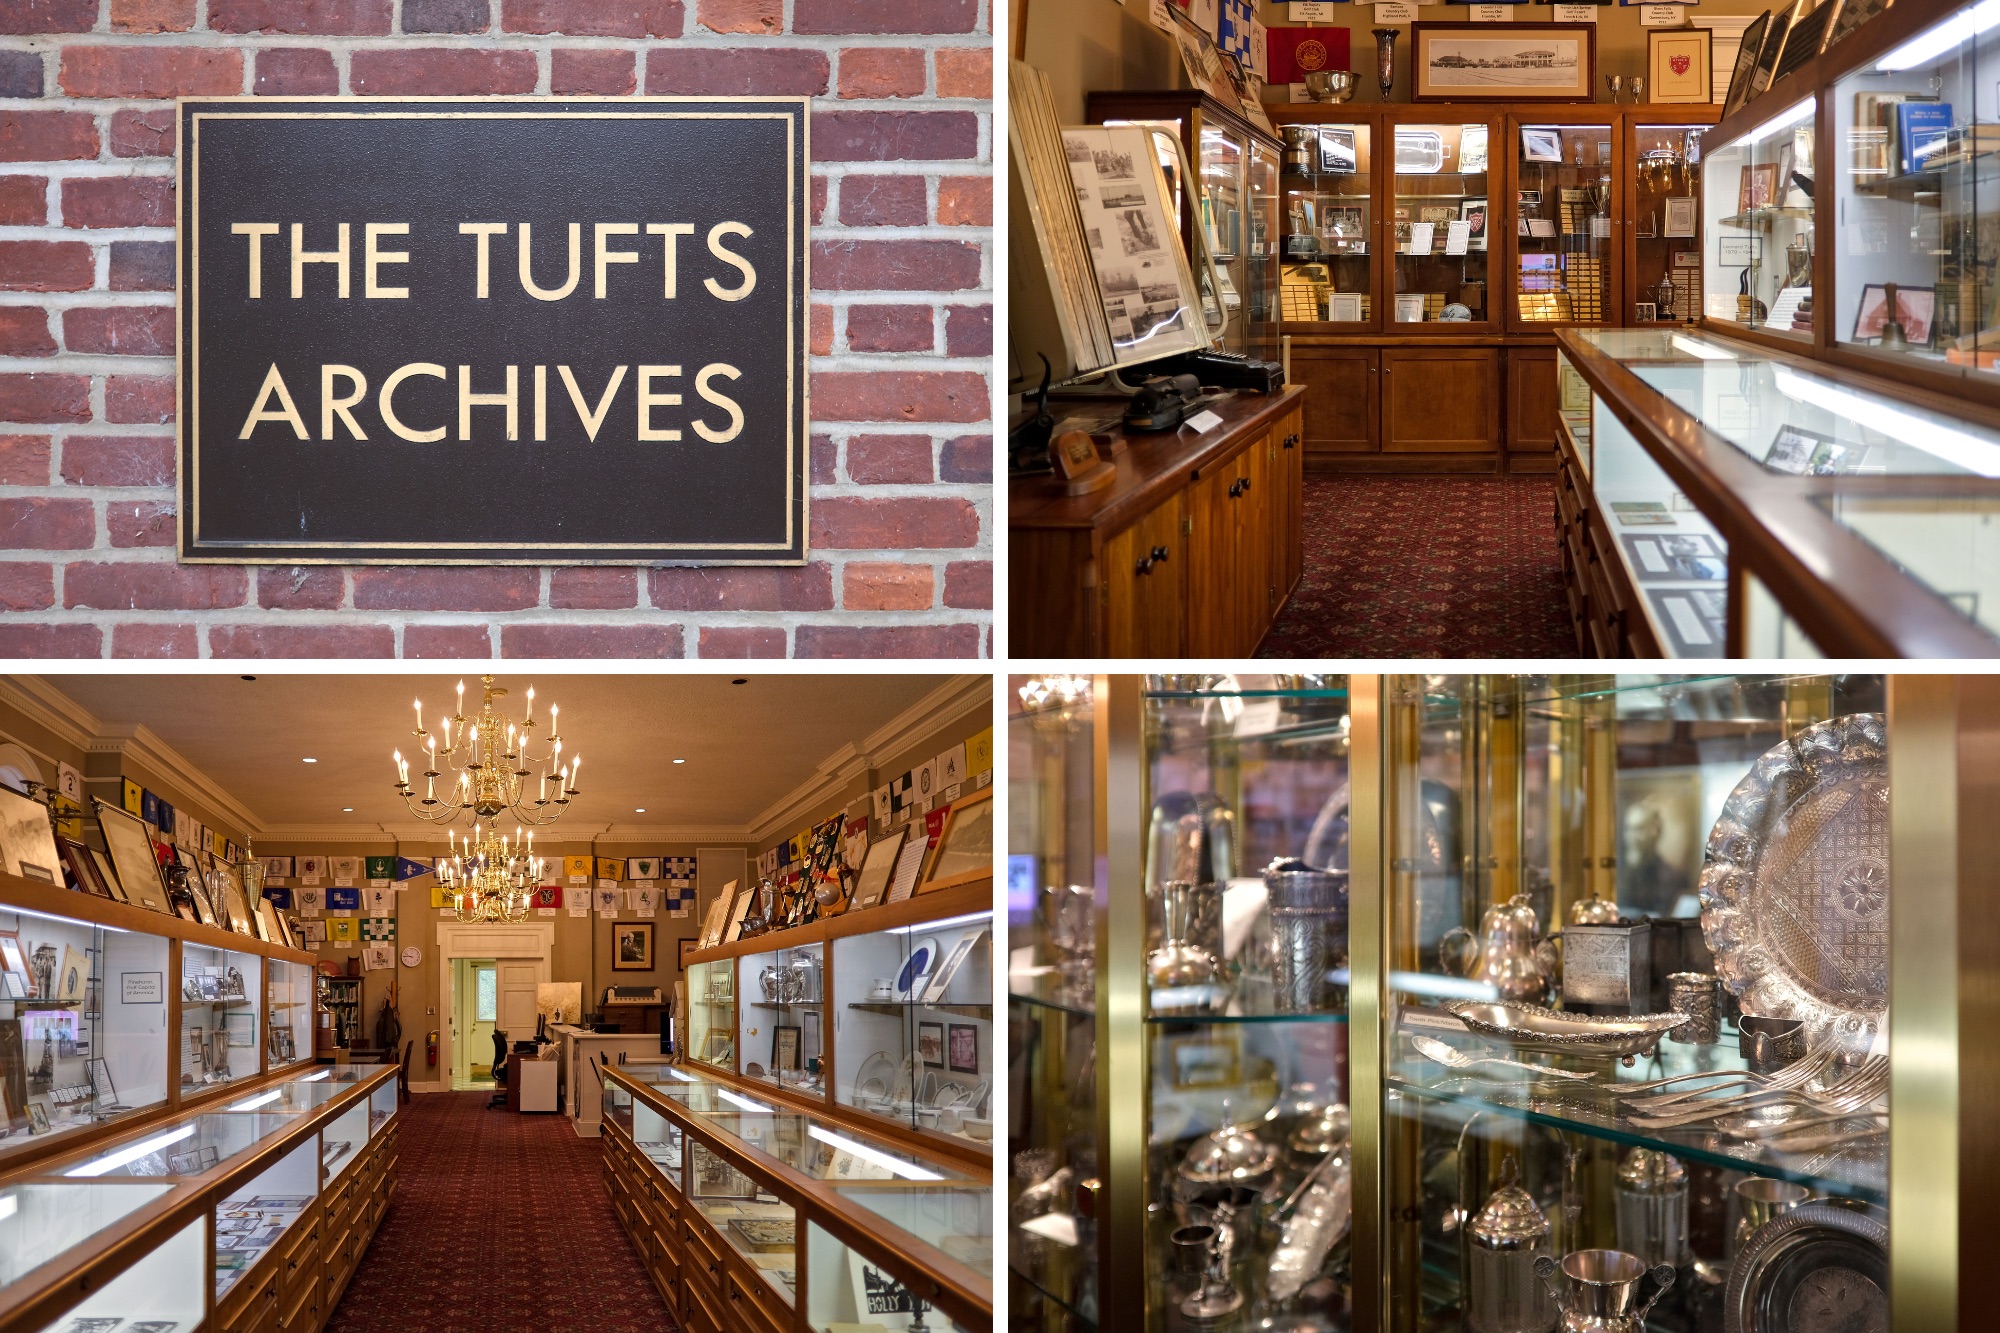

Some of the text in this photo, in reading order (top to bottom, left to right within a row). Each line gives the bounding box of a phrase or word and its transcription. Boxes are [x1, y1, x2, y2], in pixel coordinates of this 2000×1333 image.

[231, 222, 757, 301] THE TUFTS
[238, 362, 745, 443] ARCHIVES
[868, 1296, 899, 1312] HOLLY
